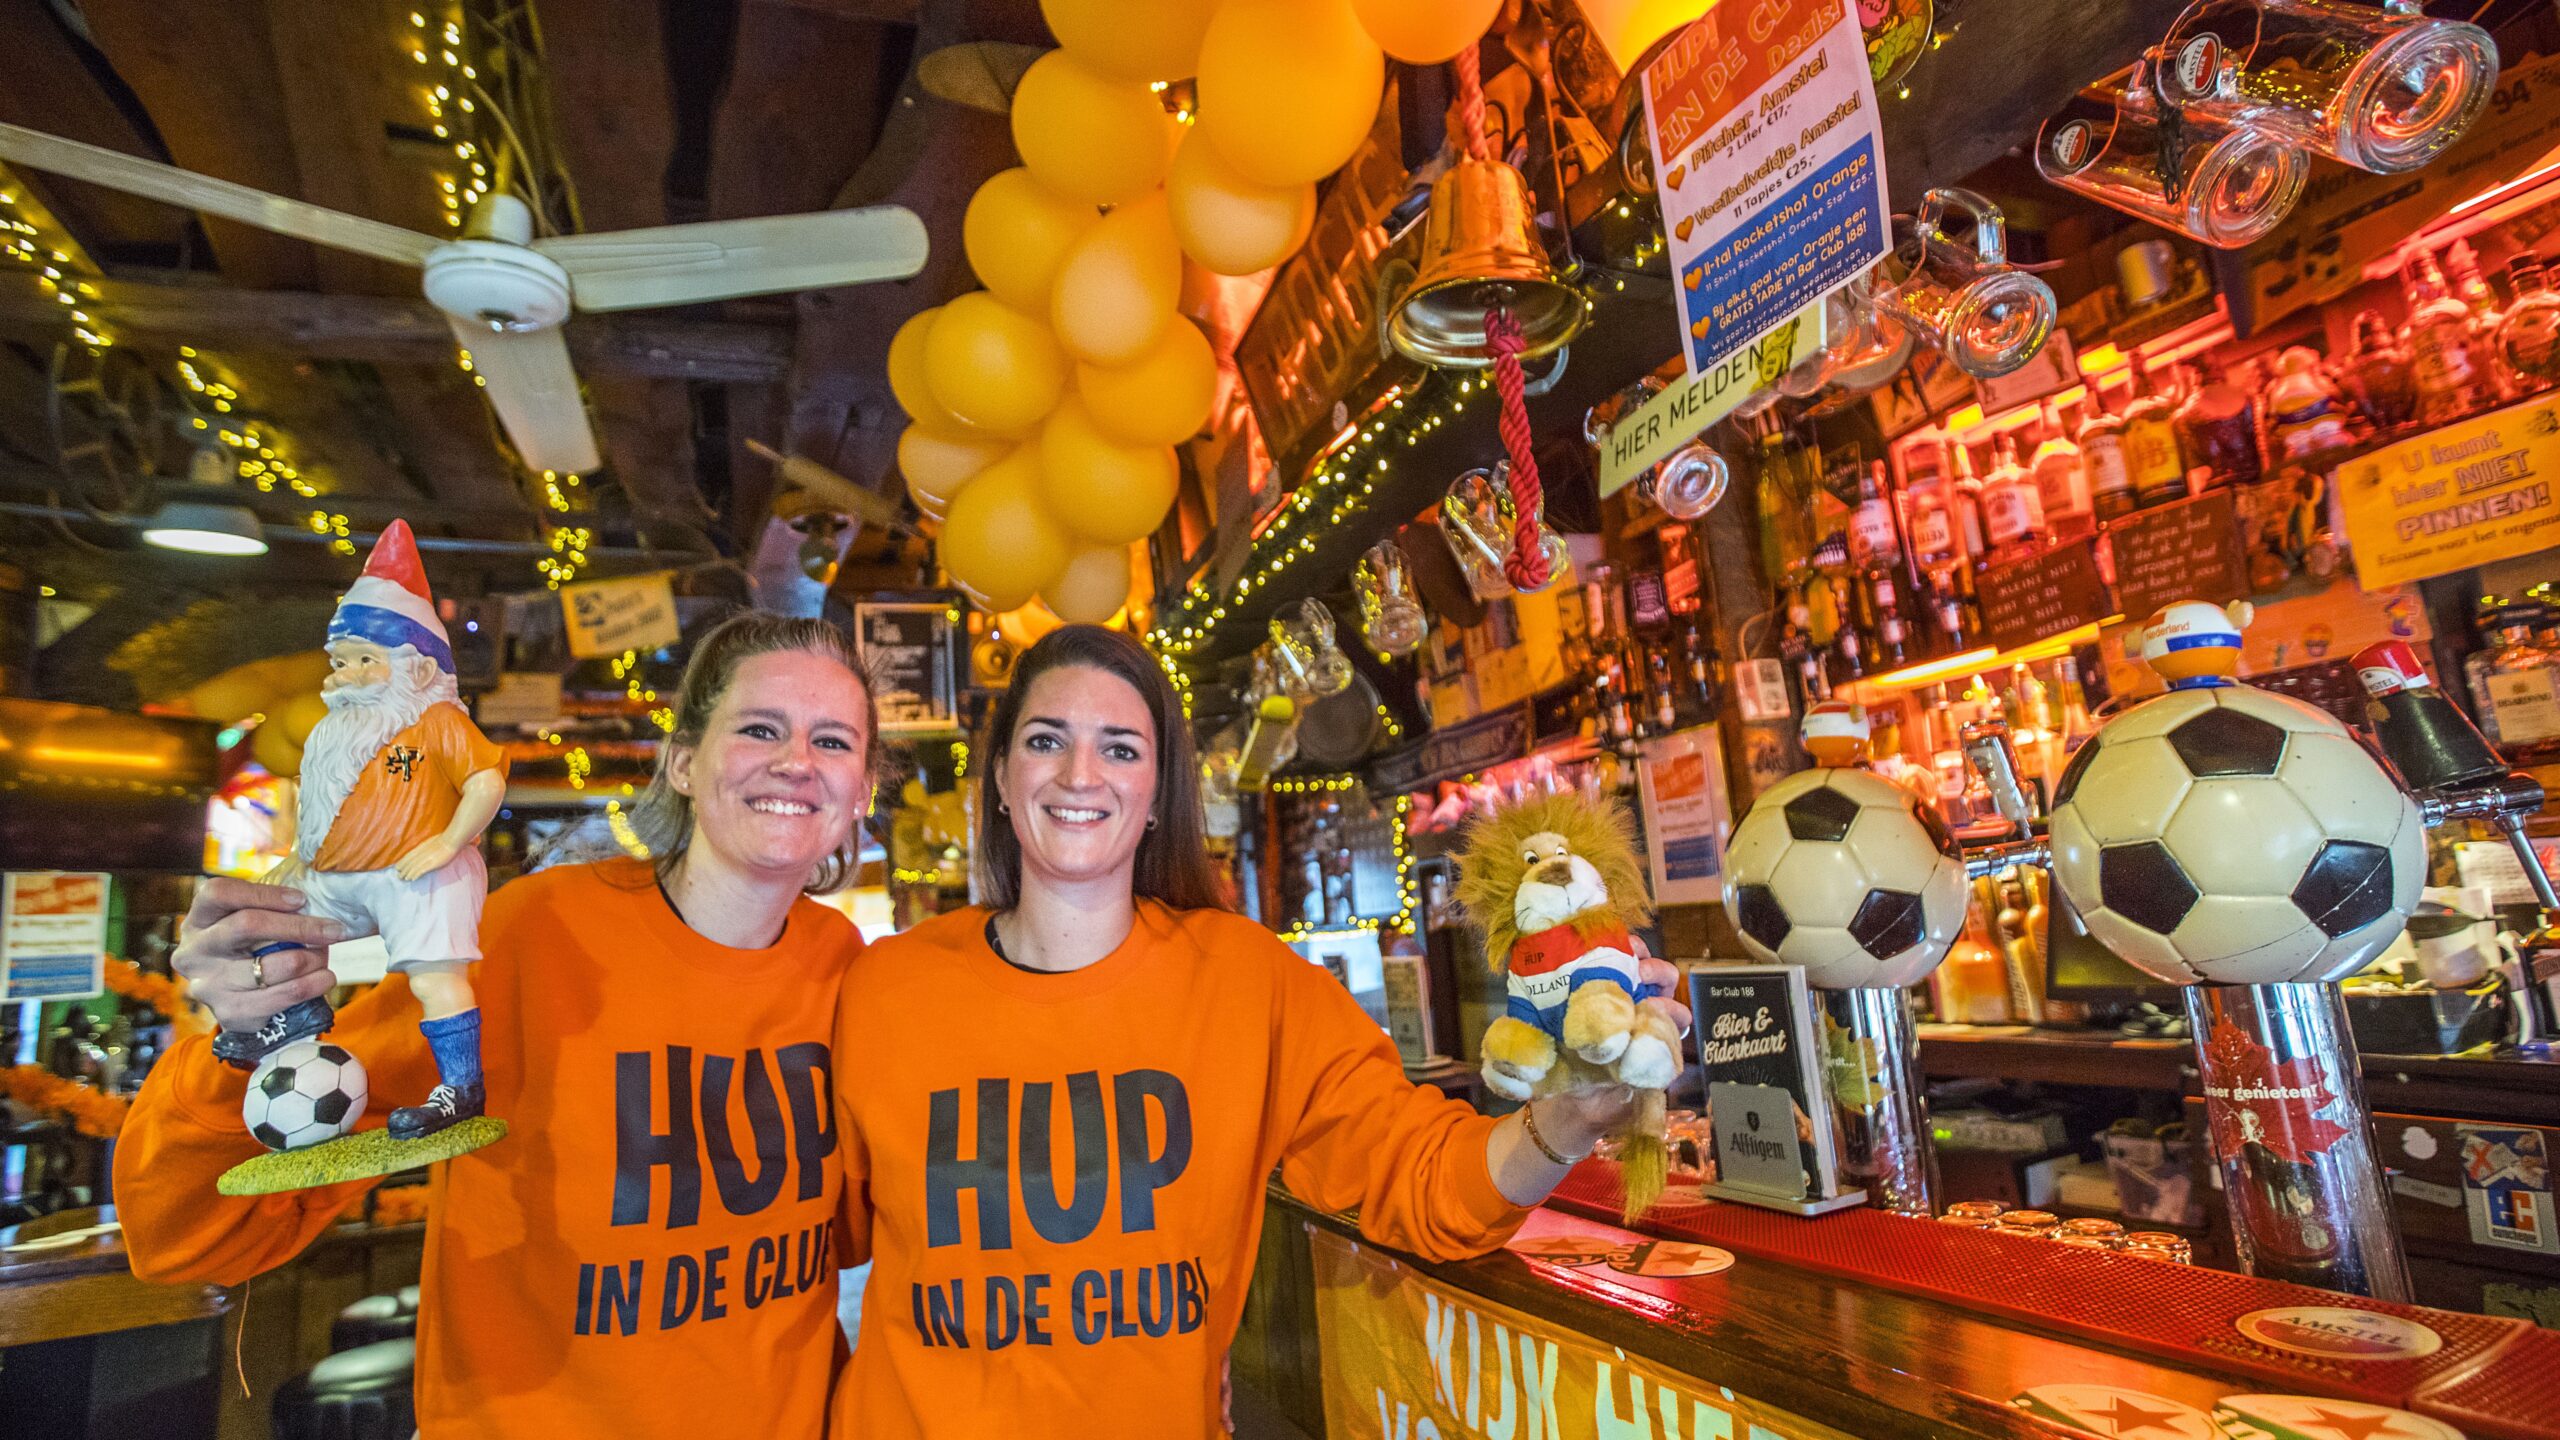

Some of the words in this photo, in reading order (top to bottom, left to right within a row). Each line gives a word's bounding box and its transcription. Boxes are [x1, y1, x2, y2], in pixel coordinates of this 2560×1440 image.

[1650, 12, 1719, 100] HUP!
[1766, 0, 1841, 75] Deals!
[2187, 43, 2204, 83] AMSTEL
[1660, 89, 1704, 156] IN
[1701, 37, 1748, 102] DE
[1691, 109, 1754, 172] Pitcher
[1760, 48, 1828, 117] Amstel
[2494, 79, 2530, 115] 94
[1694, 142, 1797, 226] Voetbalveldje
[1801, 89, 1862, 149] Amstel
[1727, 147, 1734, 158] 2
[1737, 122, 1763, 150] Liter
[1767, 103, 1792, 126] €17,-
[1733, 206, 1742, 218] 11
[1745, 178, 1783, 211] Tapjes
[1786, 153, 1816, 180] €25,-
[1733, 194, 1808, 256] Rocketshot
[1812, 152, 1868, 199] Orange
[1712, 302, 1725, 318] Bij
[1727, 287, 1748, 309] elke
[1750, 269, 1773, 294] goal
[1775, 252, 1800, 276] voor
[1803, 224, 1841, 257] Oranje
[1844, 206, 1868, 228] een
[1713, 268, 1737, 288] Shots
[1738, 232, 1786, 270] Rocketshot
[1789, 207, 1824, 235] Orange
[1827, 190, 1847, 209] Star
[1719, 299, 1754, 330] GRATIS
[1756, 280, 1784, 306] TAPJE
[1785, 270, 1796, 287] in
[1797, 256, 1818, 278] Bar
[1820, 237, 1844, 261] Club
[1790, 287, 1800, 300] de
[1615, 412, 1661, 468] HIER
[1670, 338, 1764, 429] MELDEN
[2391, 479, 2448, 507] hier
[2455, 448, 2531, 490] NIET
[2402, 450, 2424, 474] U
[2431, 430, 2503, 466] kunt
[2396, 480, 2551, 543] PINNEN!
[2049, 560, 2077, 578] NIET
[2035, 601, 2063, 619] NIET
[2035, 615, 2079, 636] WEERD
[1525, 951, 1545, 966] HUP
[1526, 974, 1571, 997] OLLAND
[1711, 986, 1723, 996] Bar
[1724, 986, 1740, 996] Club
[1741, 986, 1755, 997] 188
[1704, 1028, 1787, 1065] Ciderkaart
[1712, 1012, 1751, 1040] Bier
[1754, 1006, 1774, 1032] &
[2233, 1082, 2318, 1102] genieten!
[611, 1041, 838, 1230] HUP
[926, 1069, 1192, 1250] HUP
[1730, 1132, 1786, 1162] Affligem
[574, 1259, 644, 1337] IN
[660, 1245, 729, 1330] DE
[912, 1278, 970, 1349] IN
[985, 1274, 1053, 1351] DE
[1071, 1256, 1209, 1345] CLUB!
[2279, 1315, 2402, 1346] AMSTEL
[1425, 1292, 1560, 1440] KIJK
